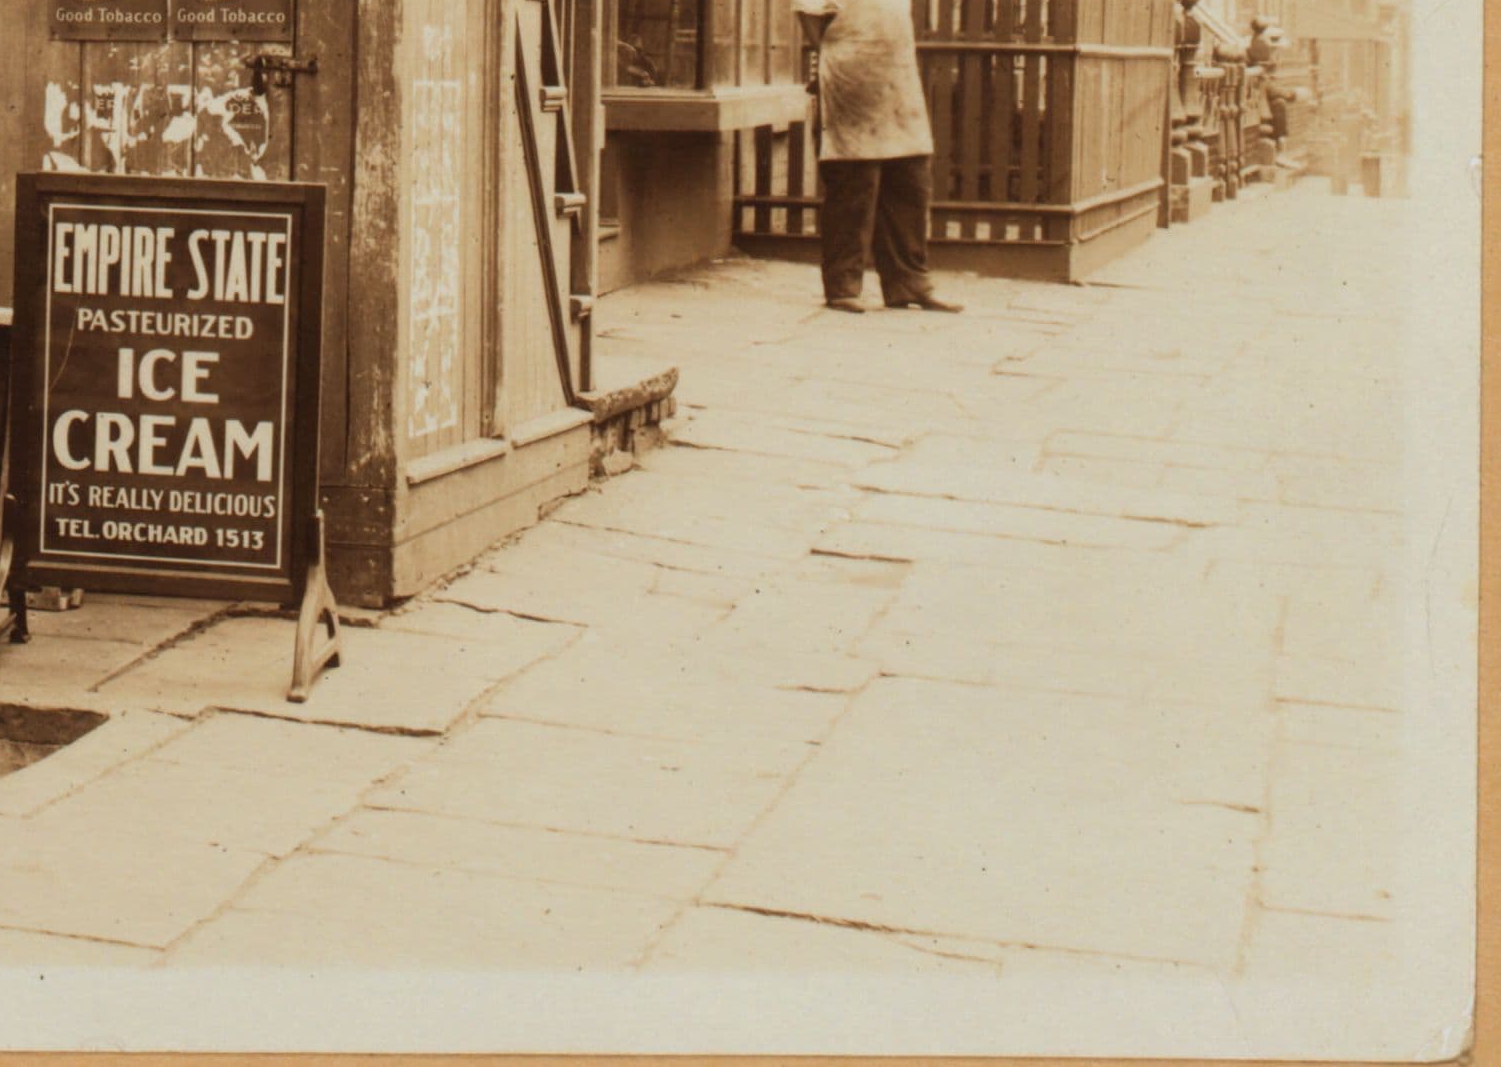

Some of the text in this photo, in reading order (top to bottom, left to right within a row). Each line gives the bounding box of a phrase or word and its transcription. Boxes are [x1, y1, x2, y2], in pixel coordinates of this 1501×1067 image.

[56, 8, 162, 23] Good Tobacco
[177, 8, 286, 23] Good Tobacco
[54, 222, 286, 304] EMPIRE STATE
[77, 308, 254, 340] PASTEURIZED
[117, 347, 220, 403] ICE
[52, 410, 273, 482] CREAM
[49, 480, 277, 518] IT'S REALLY DELICIOUS
[102, 521, 208, 546] ORCHARD
[216, 527, 265, 550] 1513
